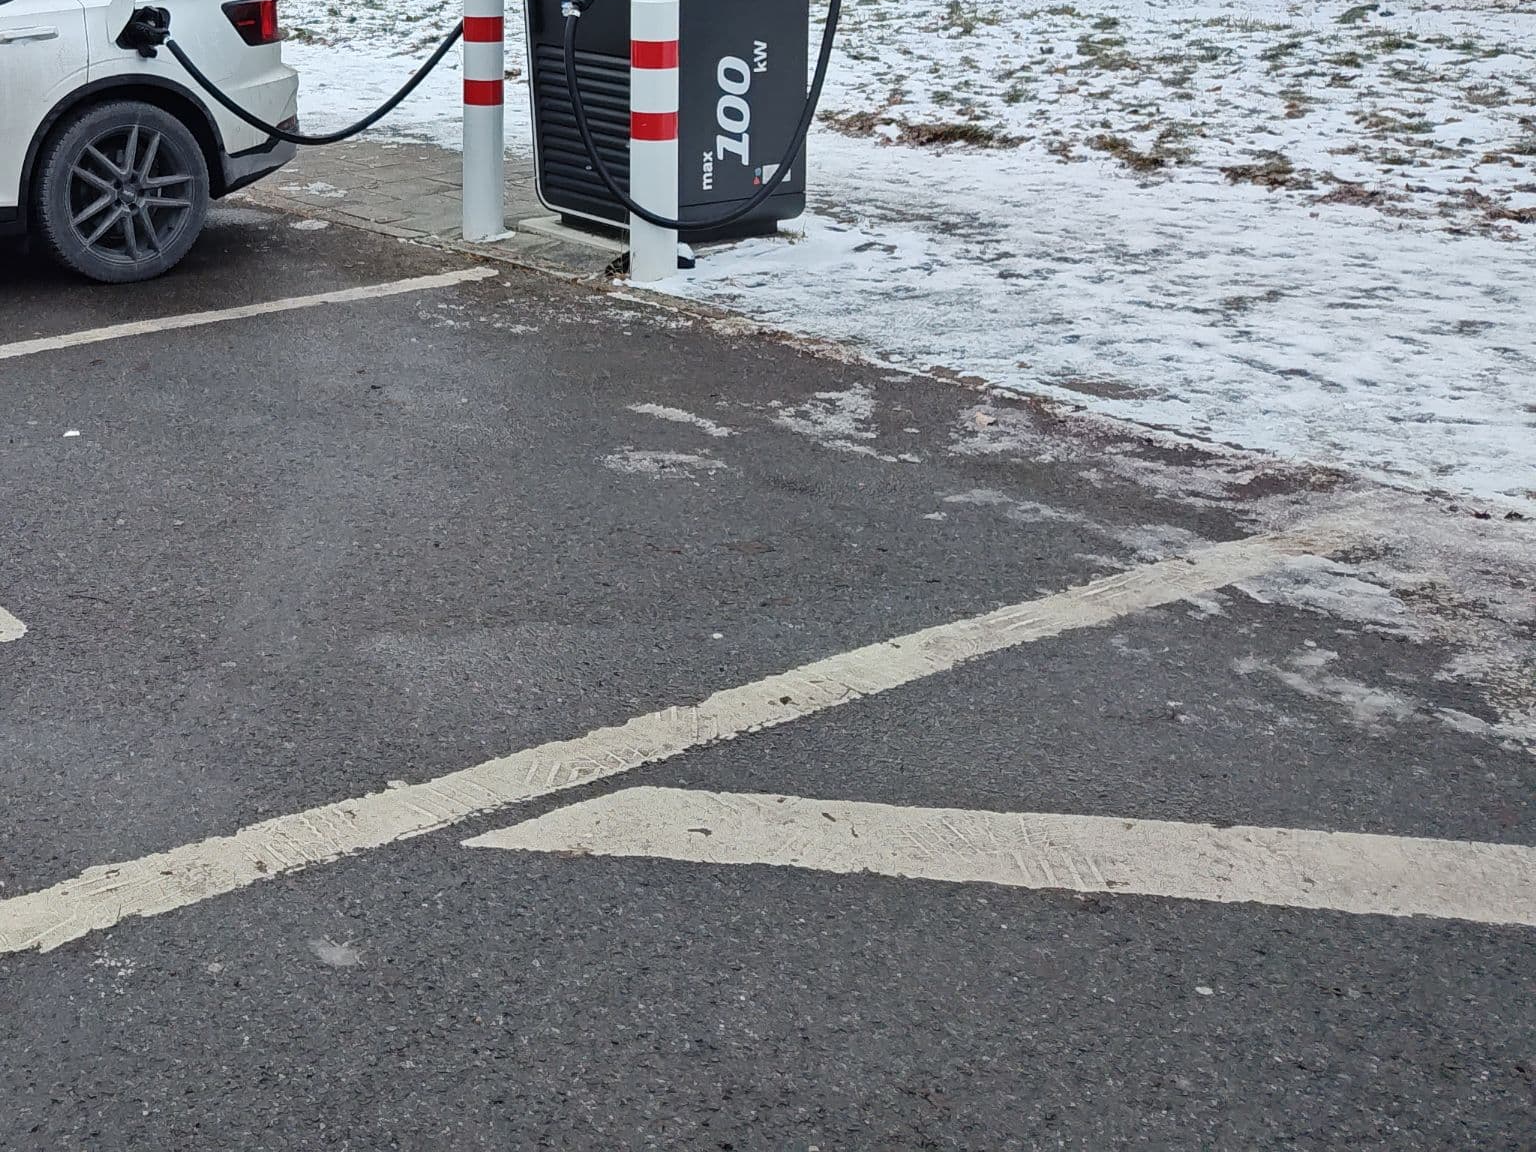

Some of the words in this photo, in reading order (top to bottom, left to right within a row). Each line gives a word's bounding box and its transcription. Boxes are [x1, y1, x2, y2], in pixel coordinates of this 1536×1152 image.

[753, 40, 768, 73] kW
[716, 56, 751, 166] 100
[702, 151, 713, 191] max
